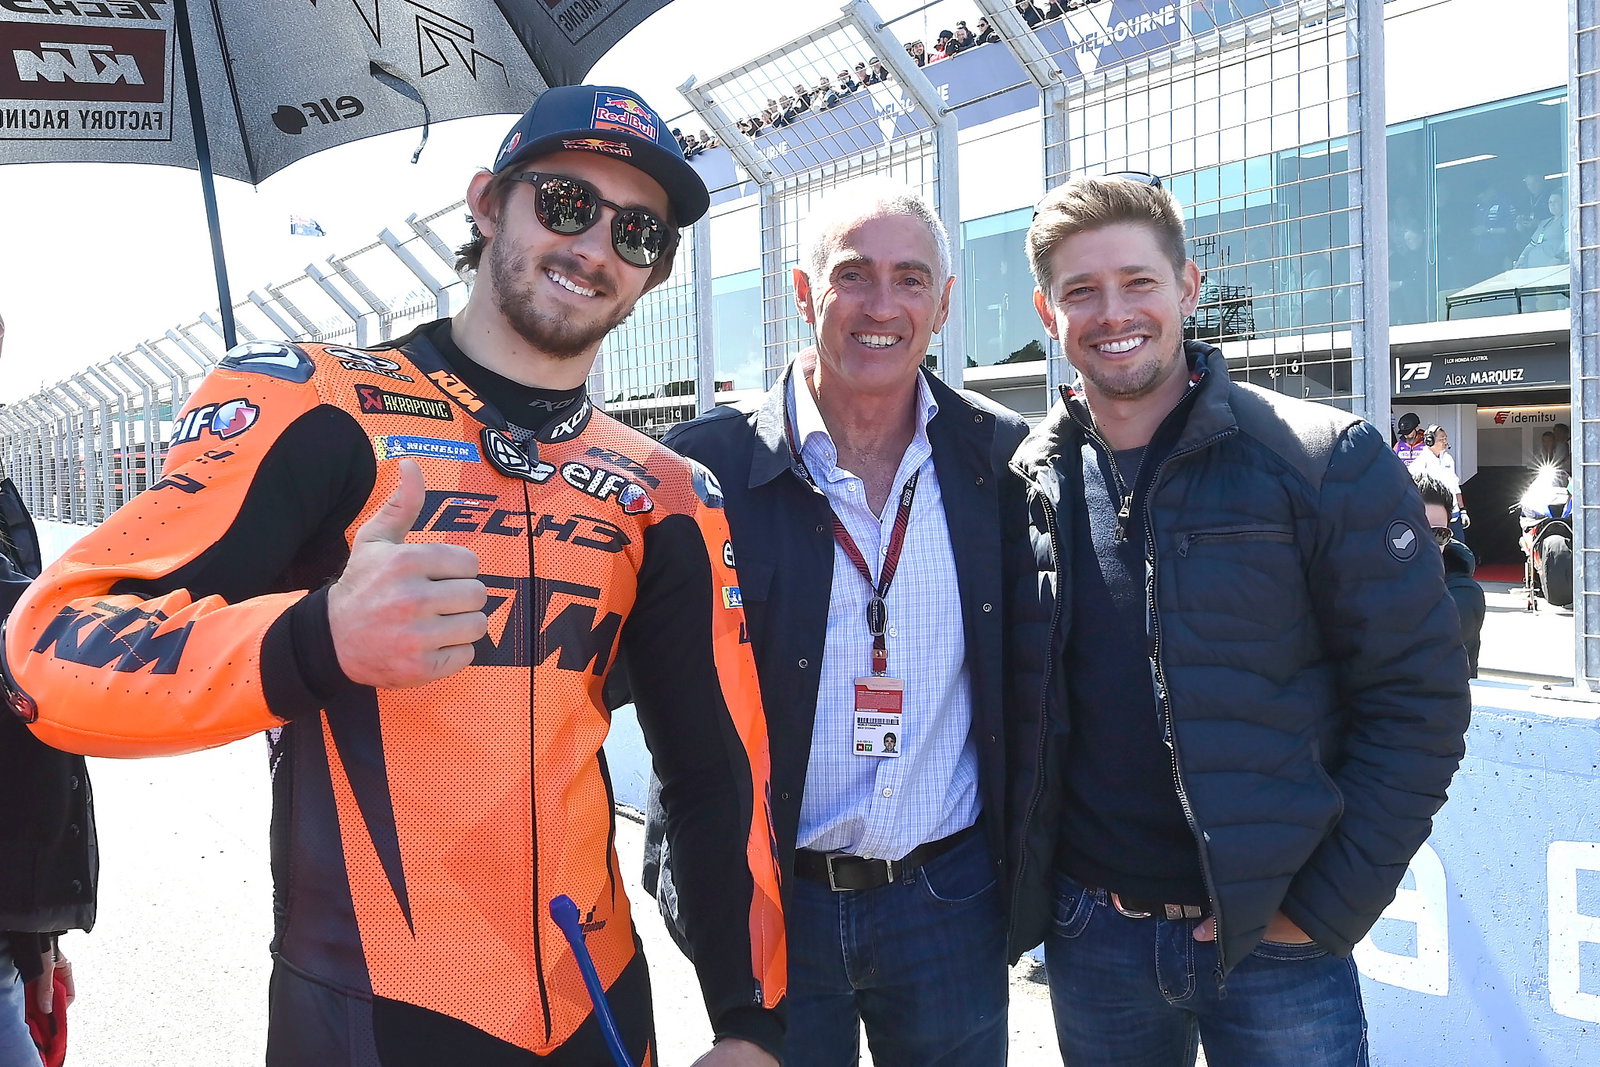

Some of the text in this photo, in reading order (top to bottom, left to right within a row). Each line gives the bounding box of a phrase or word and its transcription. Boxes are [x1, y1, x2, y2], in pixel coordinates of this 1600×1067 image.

[1071, 4, 1176, 54] MELBOURNE
[596, 107, 629, 125] Red
[629, 113, 657, 140] Bull
[1291, 360, 1300, 374] 6
[1402, 361, 1432, 380] 73
[1444, 368, 1524, 386] Alex MARQUEZ
[427, 370, 485, 413] KTM
[1511, 411, 1556, 424] idemitsu
[406, 442, 469, 455] MICHELIN
[561, 462, 625, 499] elf
[584, 446, 661, 491] KTM
[409, 490, 632, 553] TECH3
[33, 601, 196, 675] KTM
